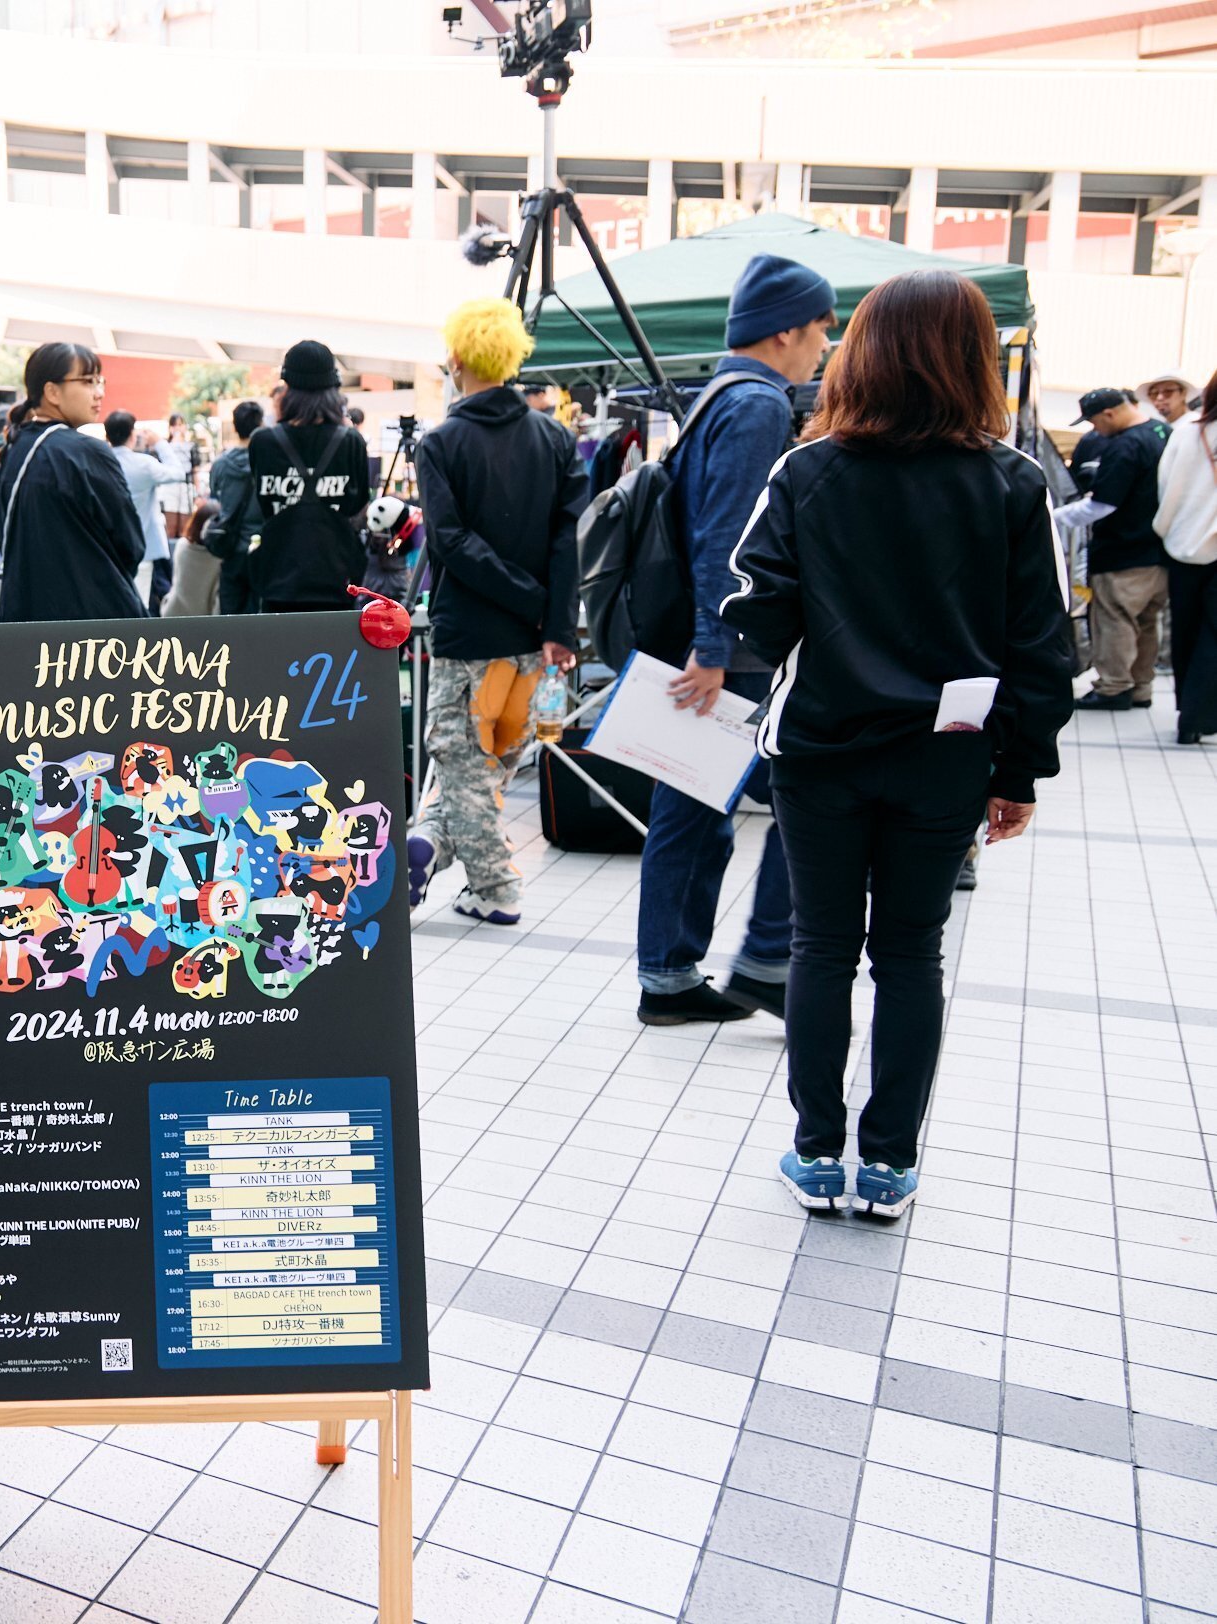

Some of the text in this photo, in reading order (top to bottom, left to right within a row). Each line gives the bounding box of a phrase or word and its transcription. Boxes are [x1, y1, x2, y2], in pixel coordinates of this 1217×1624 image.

[35, 637, 231, 687] HITOKIWA
[130, 690, 290, 742] FESTIVAL
[6, 1003, 298, 1042] 2024.11.4 mon 12:00-18:00
[83, 1039, 215, 1063] @阪急サン広場
[225, 1089, 313, 1108] Time Table
[11, 1101, 50, 1112] trench
[54, 1101, 85, 1111] town
[46, 1113, 105, 1125] 奇妙礼太郎
[265, 1117, 294, 1126] TANK
[232, 1128, 360, 1142] テクニカルフィンガーズ
[26, 1141, 102, 1153] ツナガリバンド
[266, 1146, 295, 1154] TANK
[258, 1158, 336, 1170] ザ・オイオイズ
[240, 1174, 322, 1184] KINN THE LION
[266, 1190, 331, 1202] 奇妙礼太郎
[241, 1208, 323, 1218] KINN THE LION
[25, 1220, 47, 1231] THE
[278, 1221, 323, 1232] DIVERz
[223, 1240, 241, 1249] KEI
[275, 1255, 328, 1267] 式町水晶
[224, 1275, 242, 1284] KEI
[233, 1291, 271, 1300] BAGDAD
[272, 1290, 296, 1298] CAFE
[299, 1290, 315, 1298] THE
[318, 1289, 347, 1298] trench
[284, 1304, 323, 1312] CHEHON
[263, 1318, 345, 1331] DJ特攻一番機
[272, 1336, 336, 1346] ツナガリバンド
